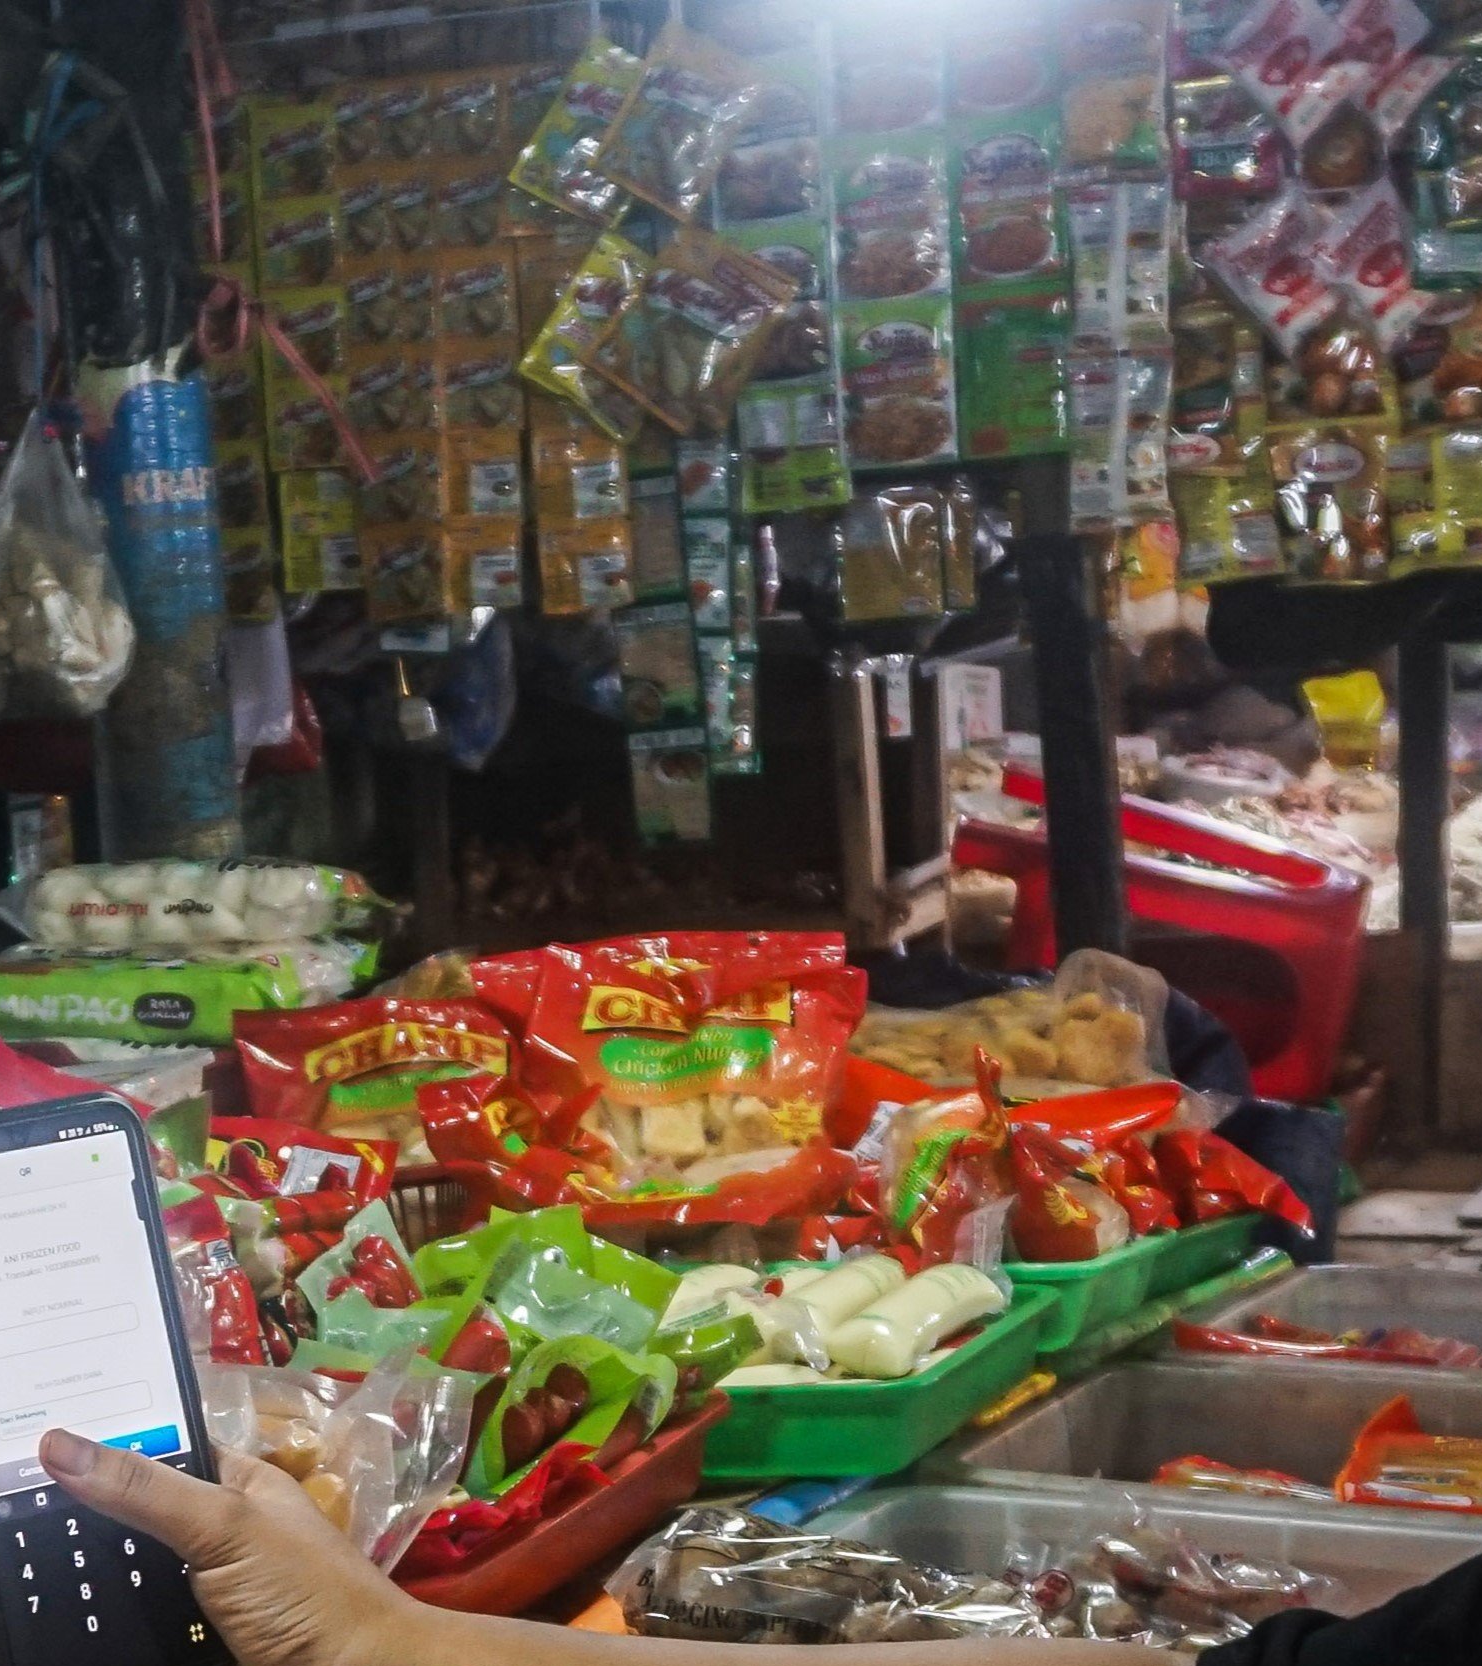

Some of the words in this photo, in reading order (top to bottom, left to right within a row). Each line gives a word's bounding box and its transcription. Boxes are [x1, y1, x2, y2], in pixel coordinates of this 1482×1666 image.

[595, 984, 784, 1026] CHP
[613, 1047, 689, 1078] Chicken
[19, 1166, 32, 1177] QR
[3, 1253, 19, 1265] ANI
[21, 1246, 56, 1262] FROZEN
[57, 1241, 81, 1255] FOOD
[47, 1298, 83, 1312] NOMINAL
[130, 1440, 143, 1452] OK
[15, 1531, 26, 1548] 1
[66, 1518, 79, 1536] 2
[22, 1563, 34, 1580] 4
[73, 1550, 85, 1568] 5
[123, 1538, 136, 1555] 6
[27, 1595, 40, 1614] 7
[80, 1582, 92, 1600] 8
[130, 1570, 142, 1587] 9
[86, 1615, 99, 1633] 0
